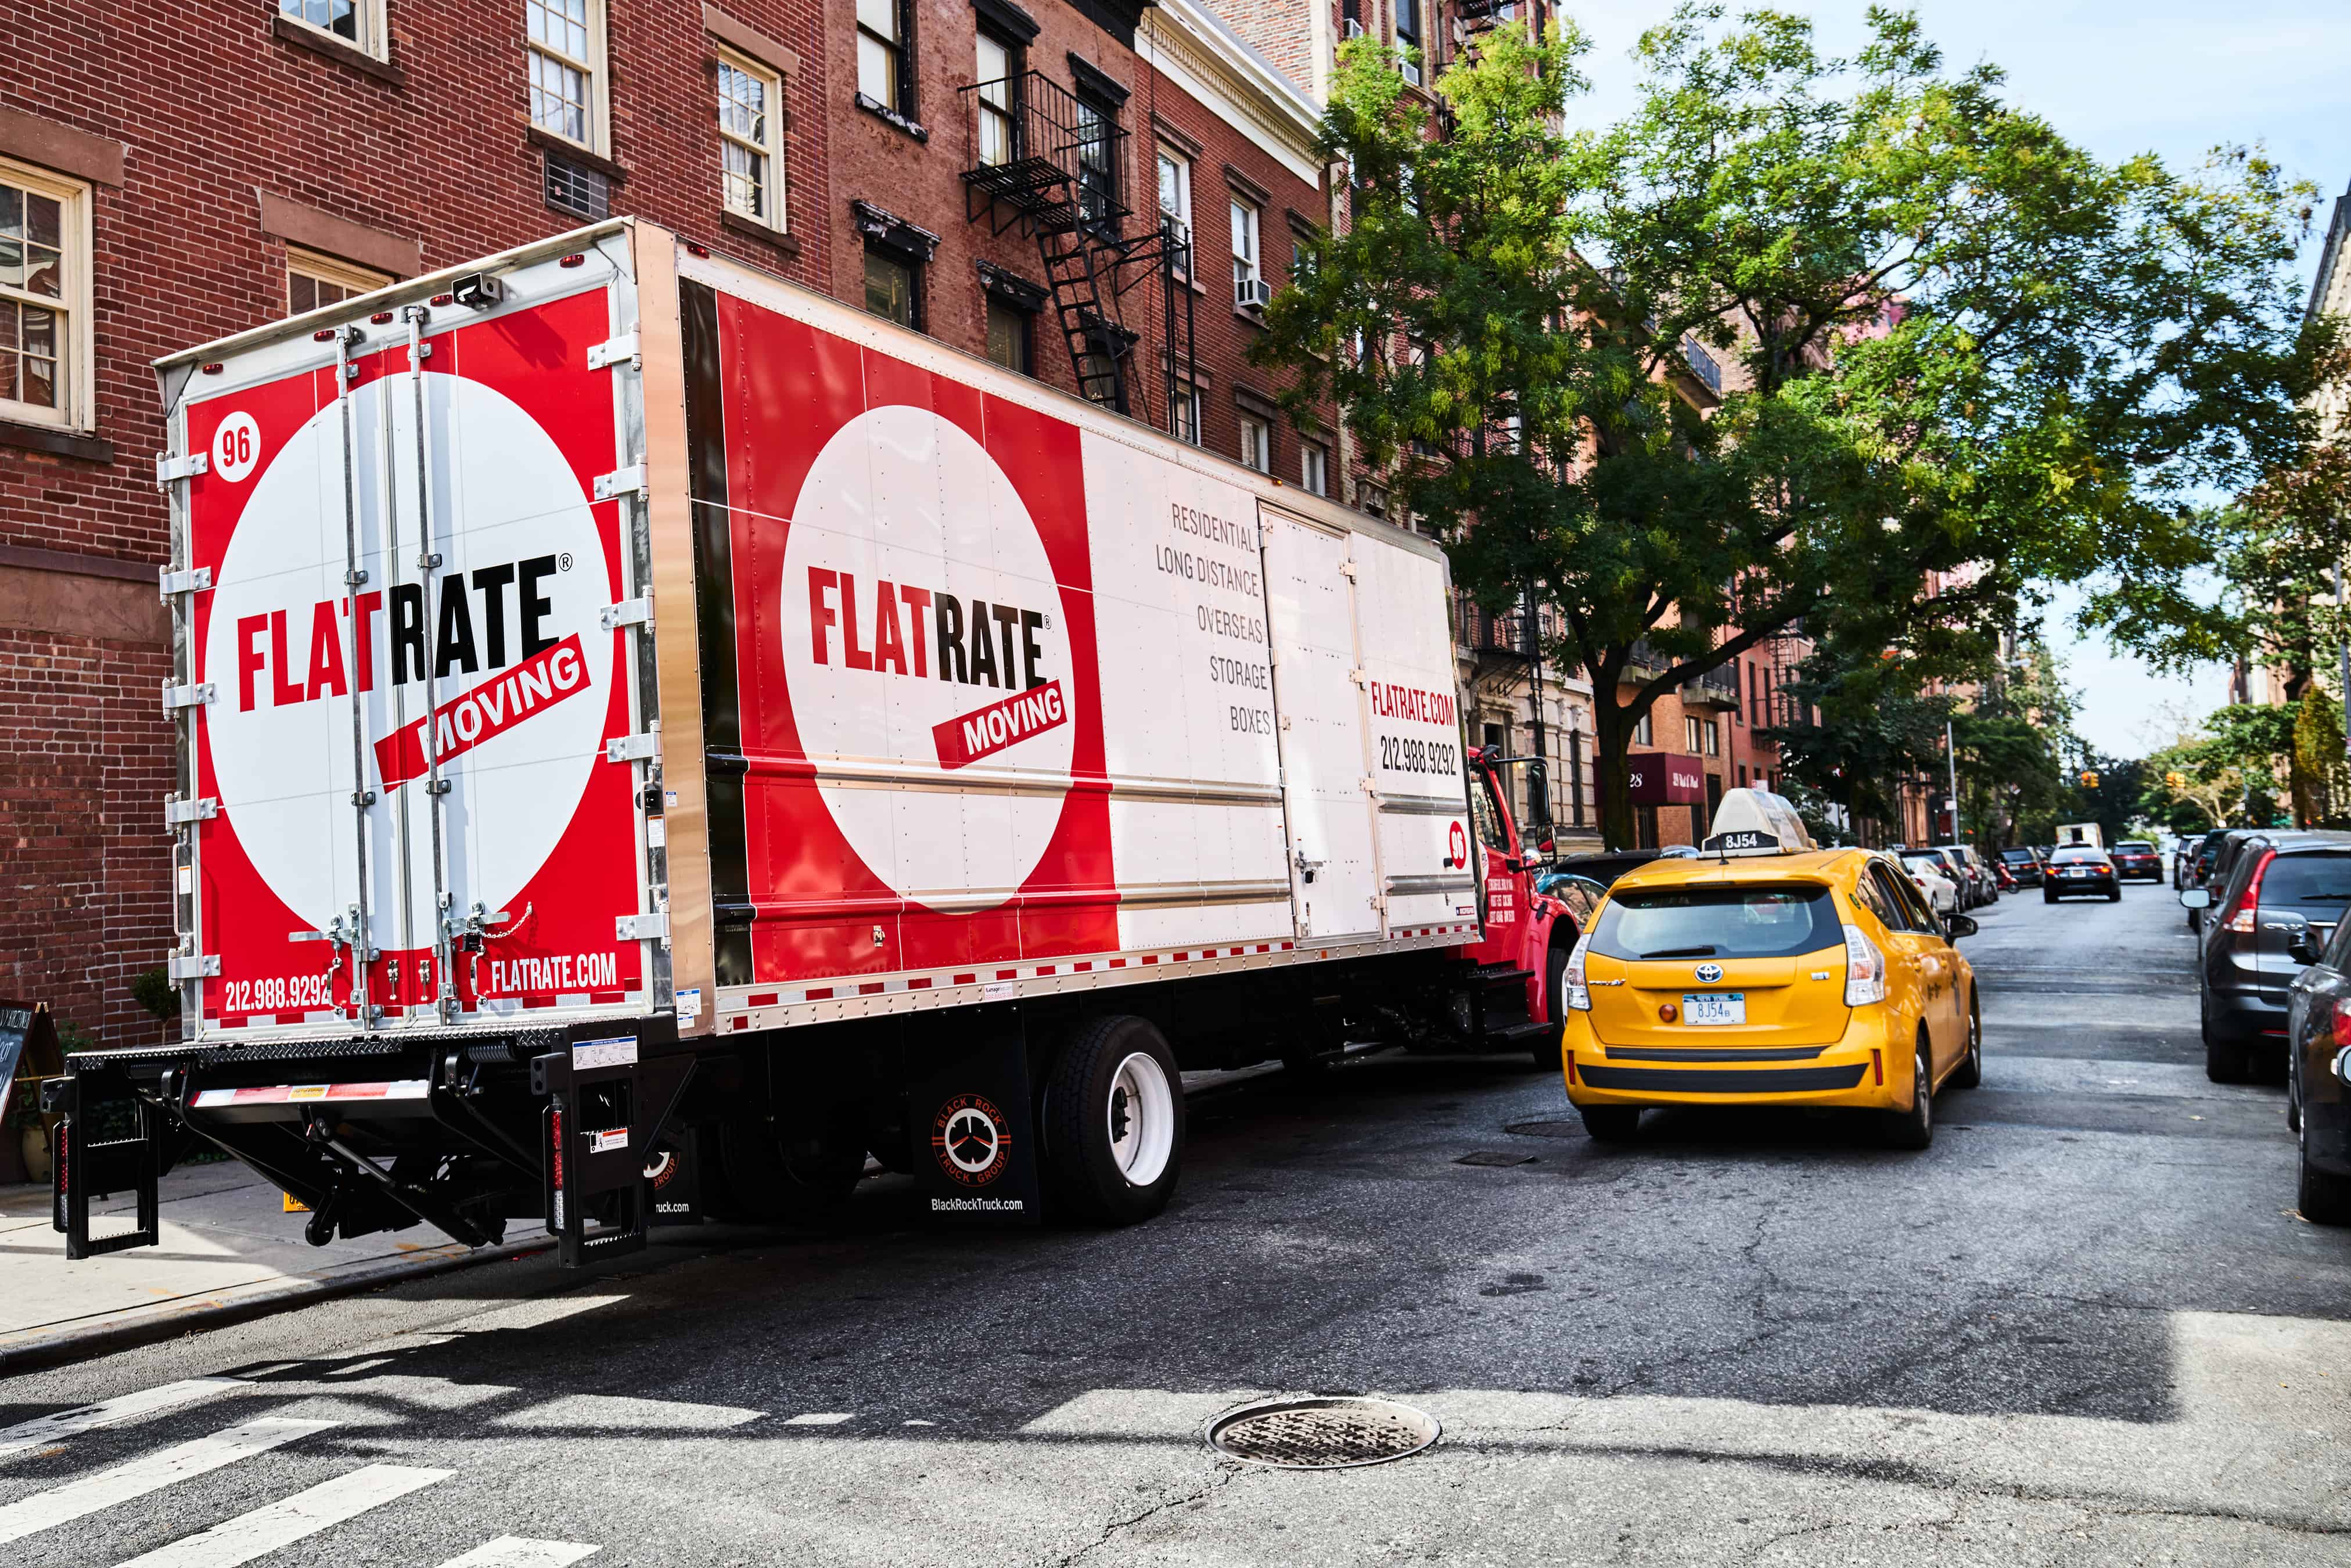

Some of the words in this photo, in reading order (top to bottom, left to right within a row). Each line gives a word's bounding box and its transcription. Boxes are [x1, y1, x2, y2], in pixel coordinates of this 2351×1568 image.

[223, 426, 250, 467] 96
[1172, 503, 1256, 553] RESIDENTIAL
[1156, 544, 1193, 580] LONG
[1196, 557, 1259, 598] DISTANCE
[1198, 605, 1263, 644] OVERSEAS
[1210, 655, 1267, 690] STORAGE
[417, 647, 580, 764] MOVING
[962, 688, 1062, 756] MOVING
[1230, 706, 1271, 735] BOXES
[1371, 681, 1455, 727] FLATRATE.COM
[1380, 735, 1457, 776] 212.988.9292
[1451, 831, 1464, 859] 96
[1725, 833, 1757, 849] 8J54
[491, 952, 617, 992] FLATRATE.COM
[225, 974, 329, 1012] 212.988.9292
[937, 1097, 968, 1129] BLACK
[975, 1099, 1002, 1126] ROCK
[939, 1152, 970, 1183] TRUCK
[977, 1151, 1005, 1183] GROUP
[656, 1201, 689, 1213] ruck.com
[931, 1197, 1023, 1210] BlackRockTruck.com
